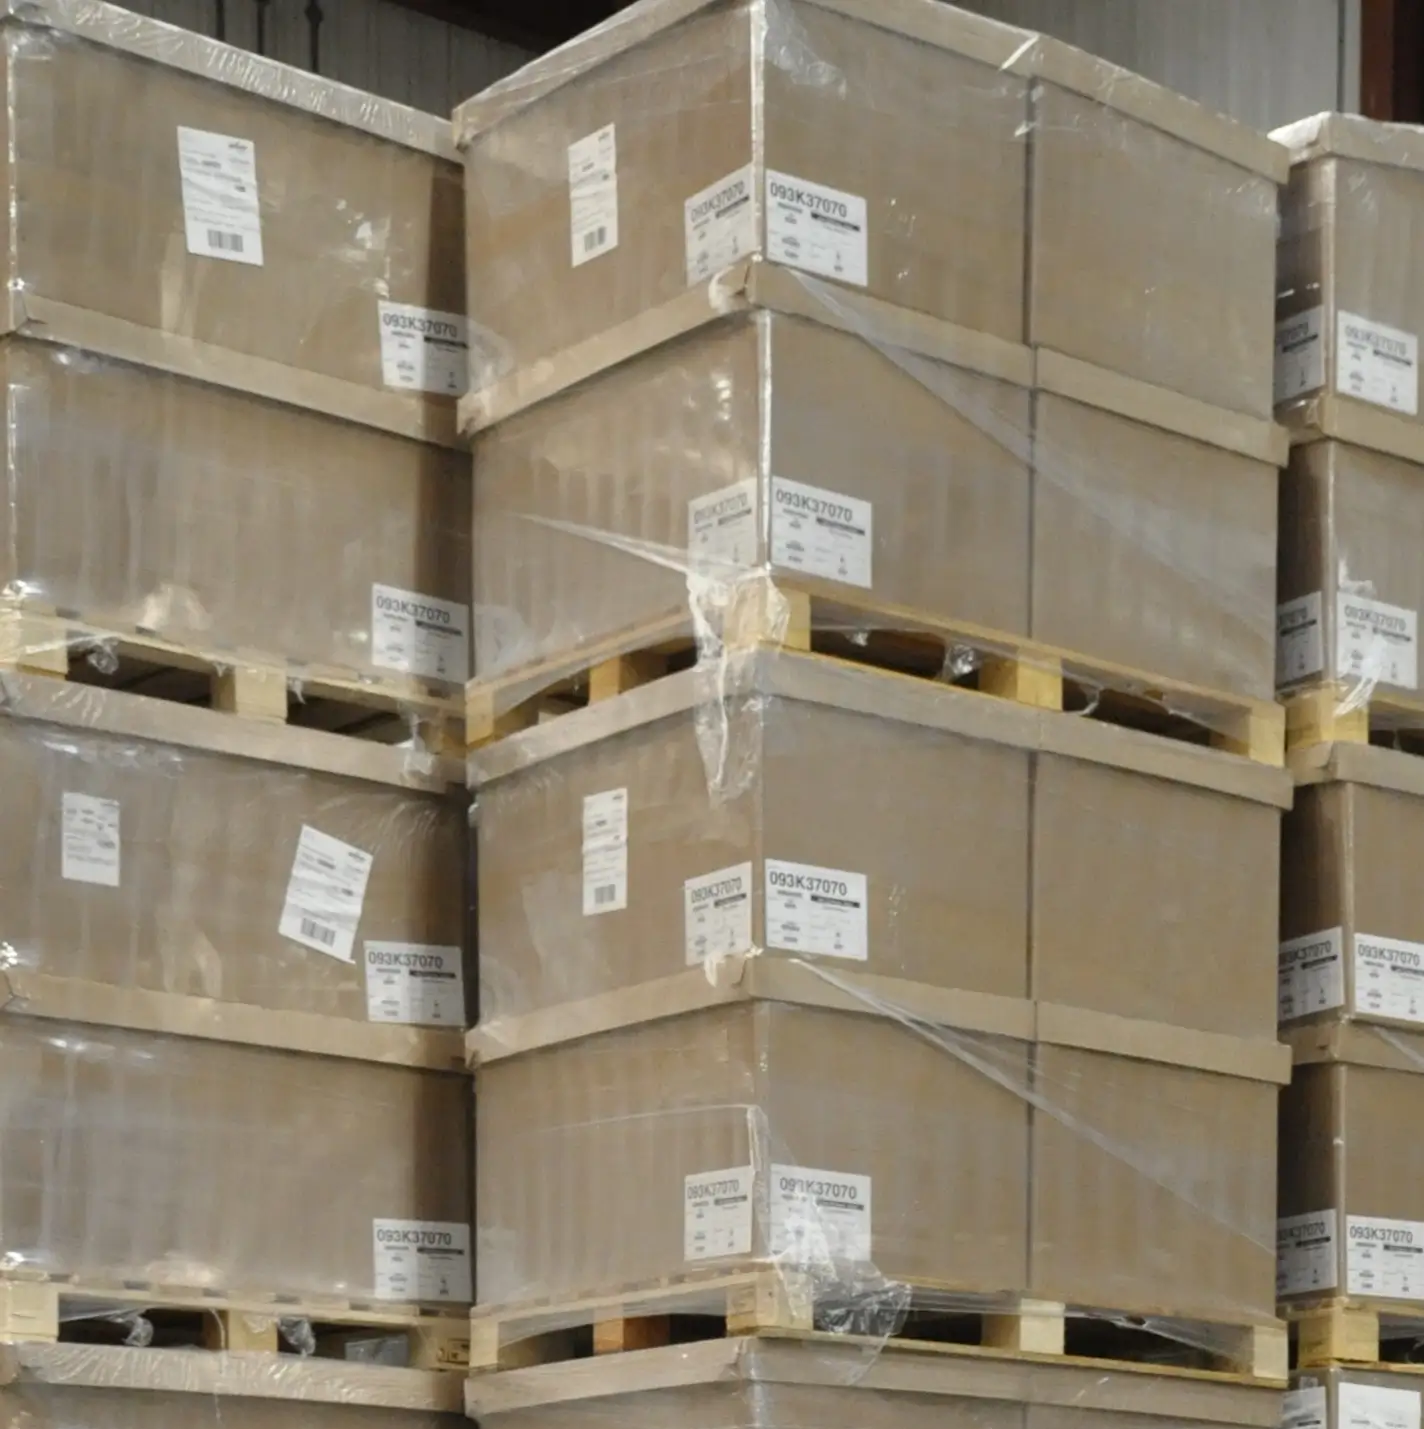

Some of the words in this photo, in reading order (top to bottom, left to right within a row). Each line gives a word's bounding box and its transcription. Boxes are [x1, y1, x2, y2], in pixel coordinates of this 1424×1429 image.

[770, 182, 847, 218] 093K37070
[383, 312, 457, 338] 093K37070
[775, 489, 853, 524] 093K37070
[376, 595, 450, 624] 093K37070
[769, 871, 847, 897] 093K37070
[368, 949, 444, 970] 093K37070
[1358, 943, 1421, 966] 093K37070
[376, 1228, 452, 1246] 093K37070
[1349, 1225, 1413, 1244] 093K37070
